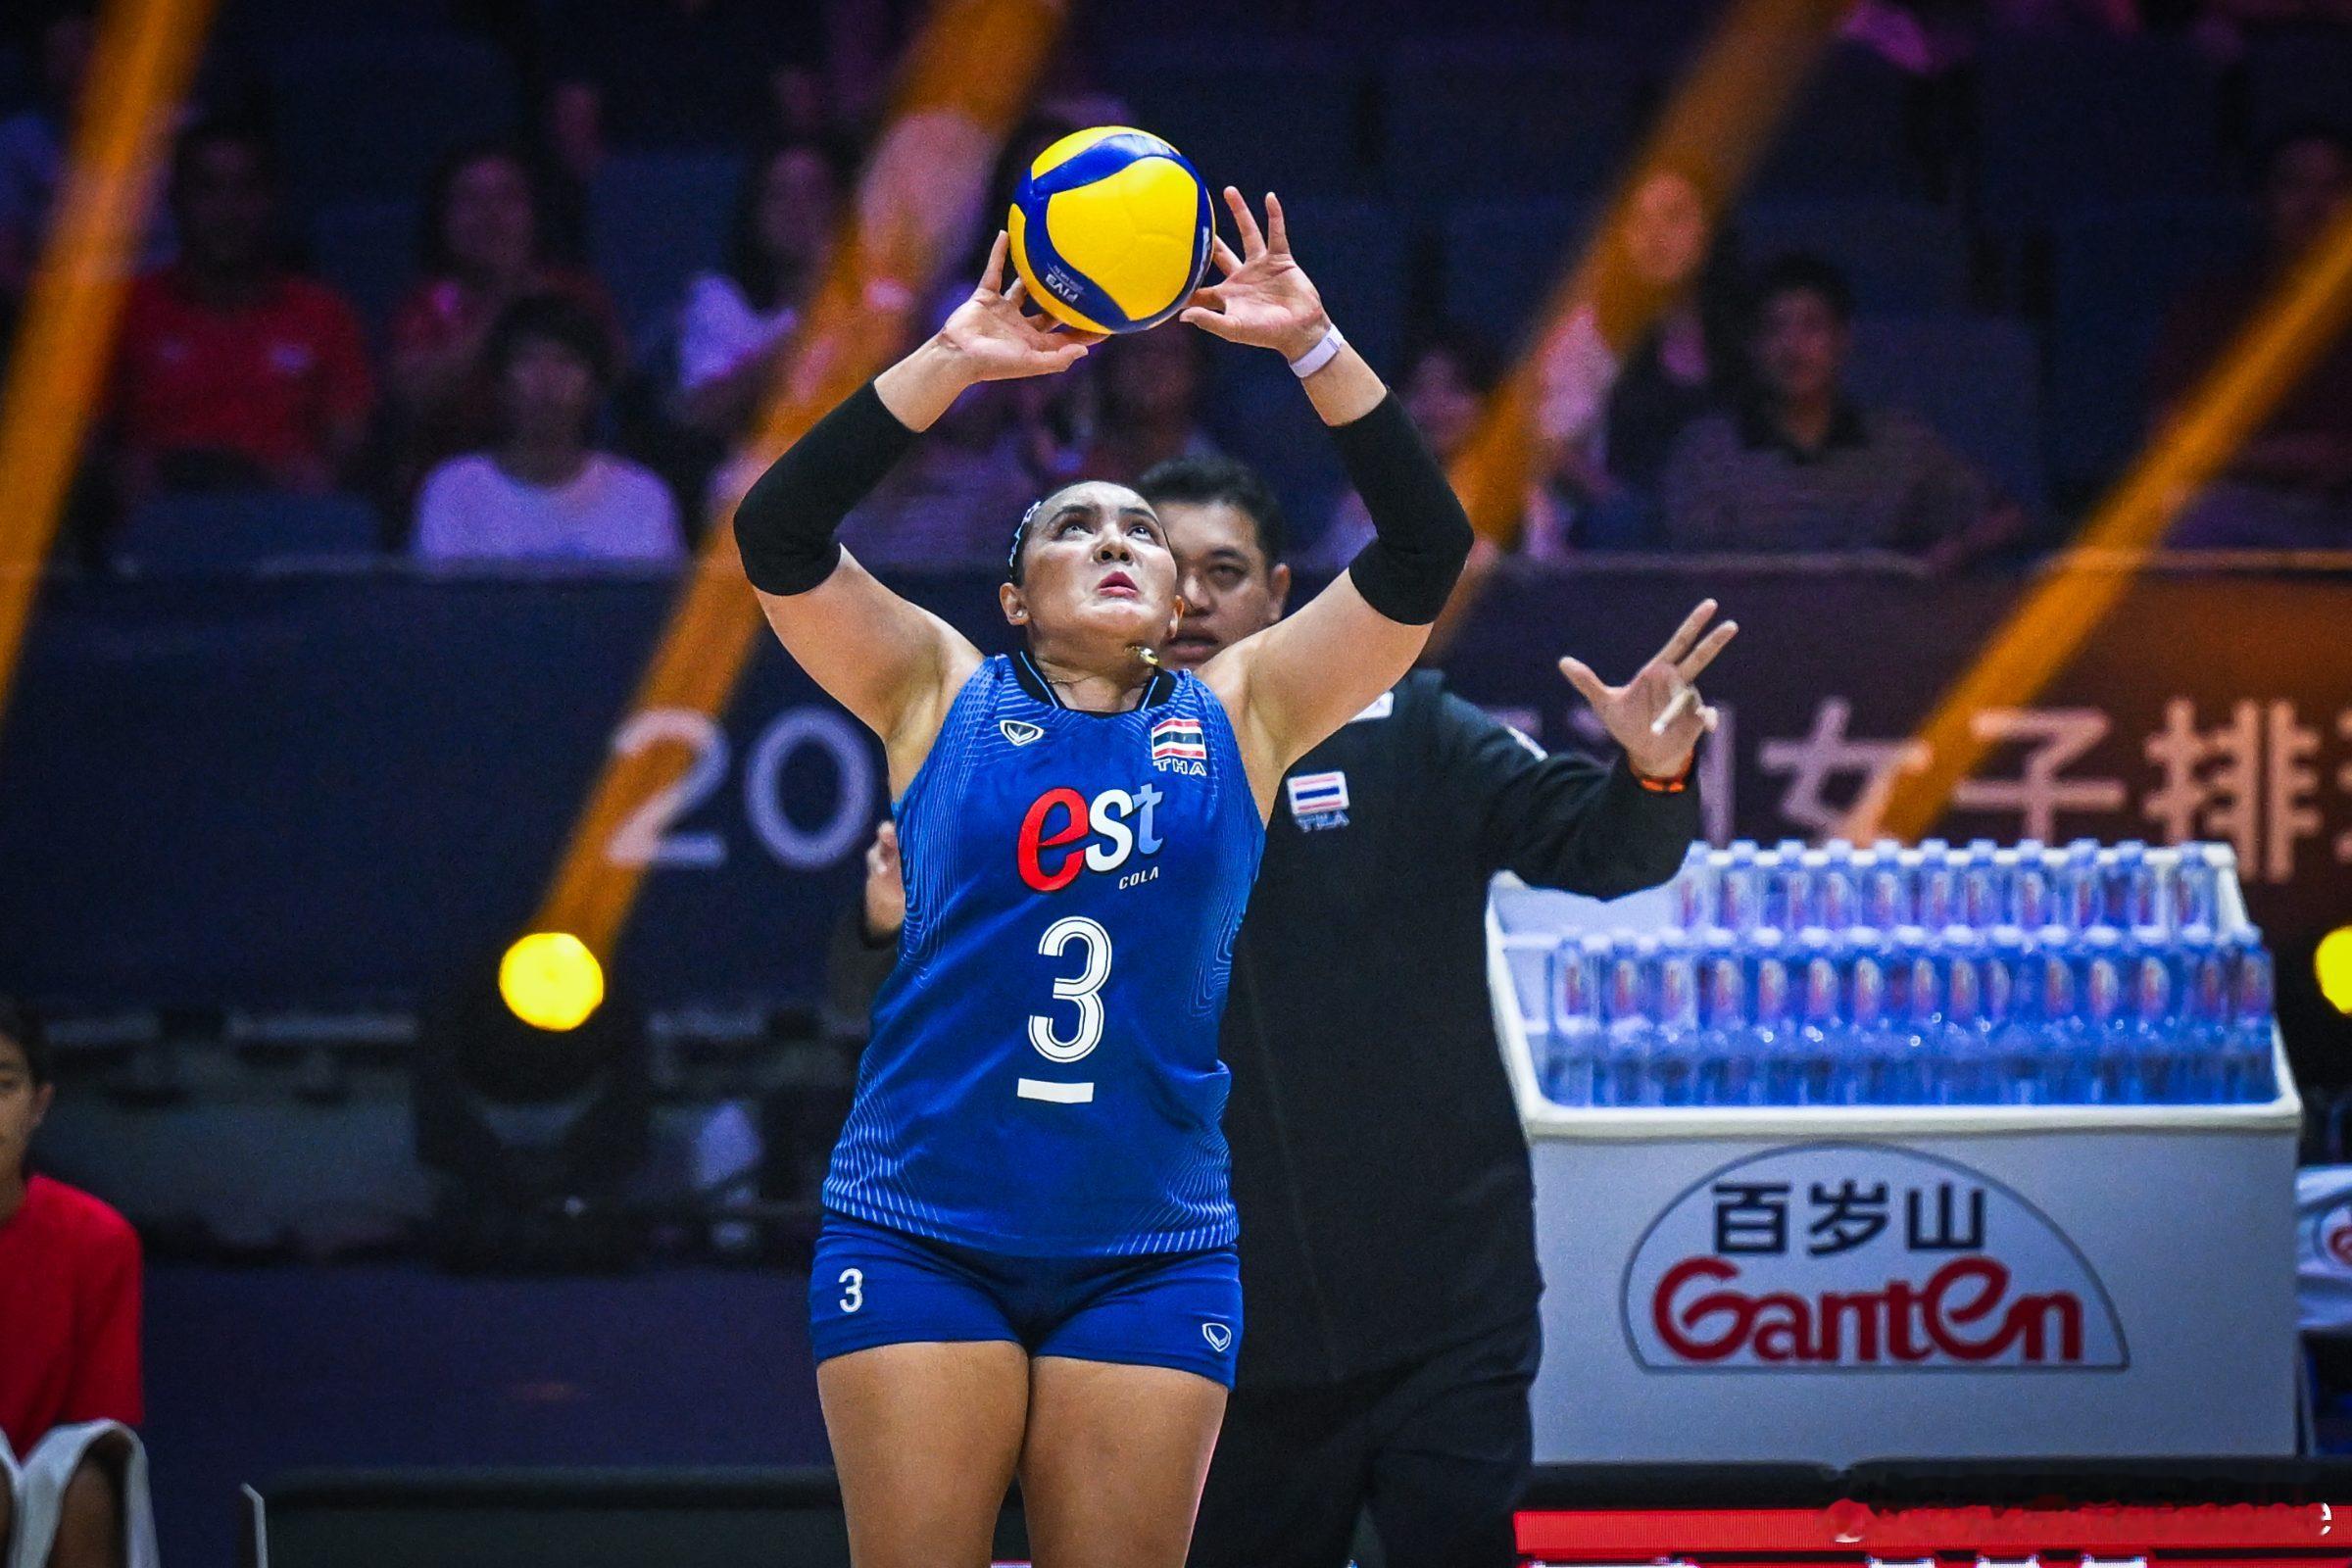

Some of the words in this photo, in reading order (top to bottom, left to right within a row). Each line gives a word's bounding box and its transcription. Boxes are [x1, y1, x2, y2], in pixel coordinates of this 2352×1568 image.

[1152, 758, 1207, 776] THA
[1017, 783, 1164, 891] est
[1118, 865, 1159, 890] COLA
[1027, 915, 1113, 1063] 3
[1713, 1180, 1985, 1255] 百岁山
[838, 1267, 863, 1313] 3
